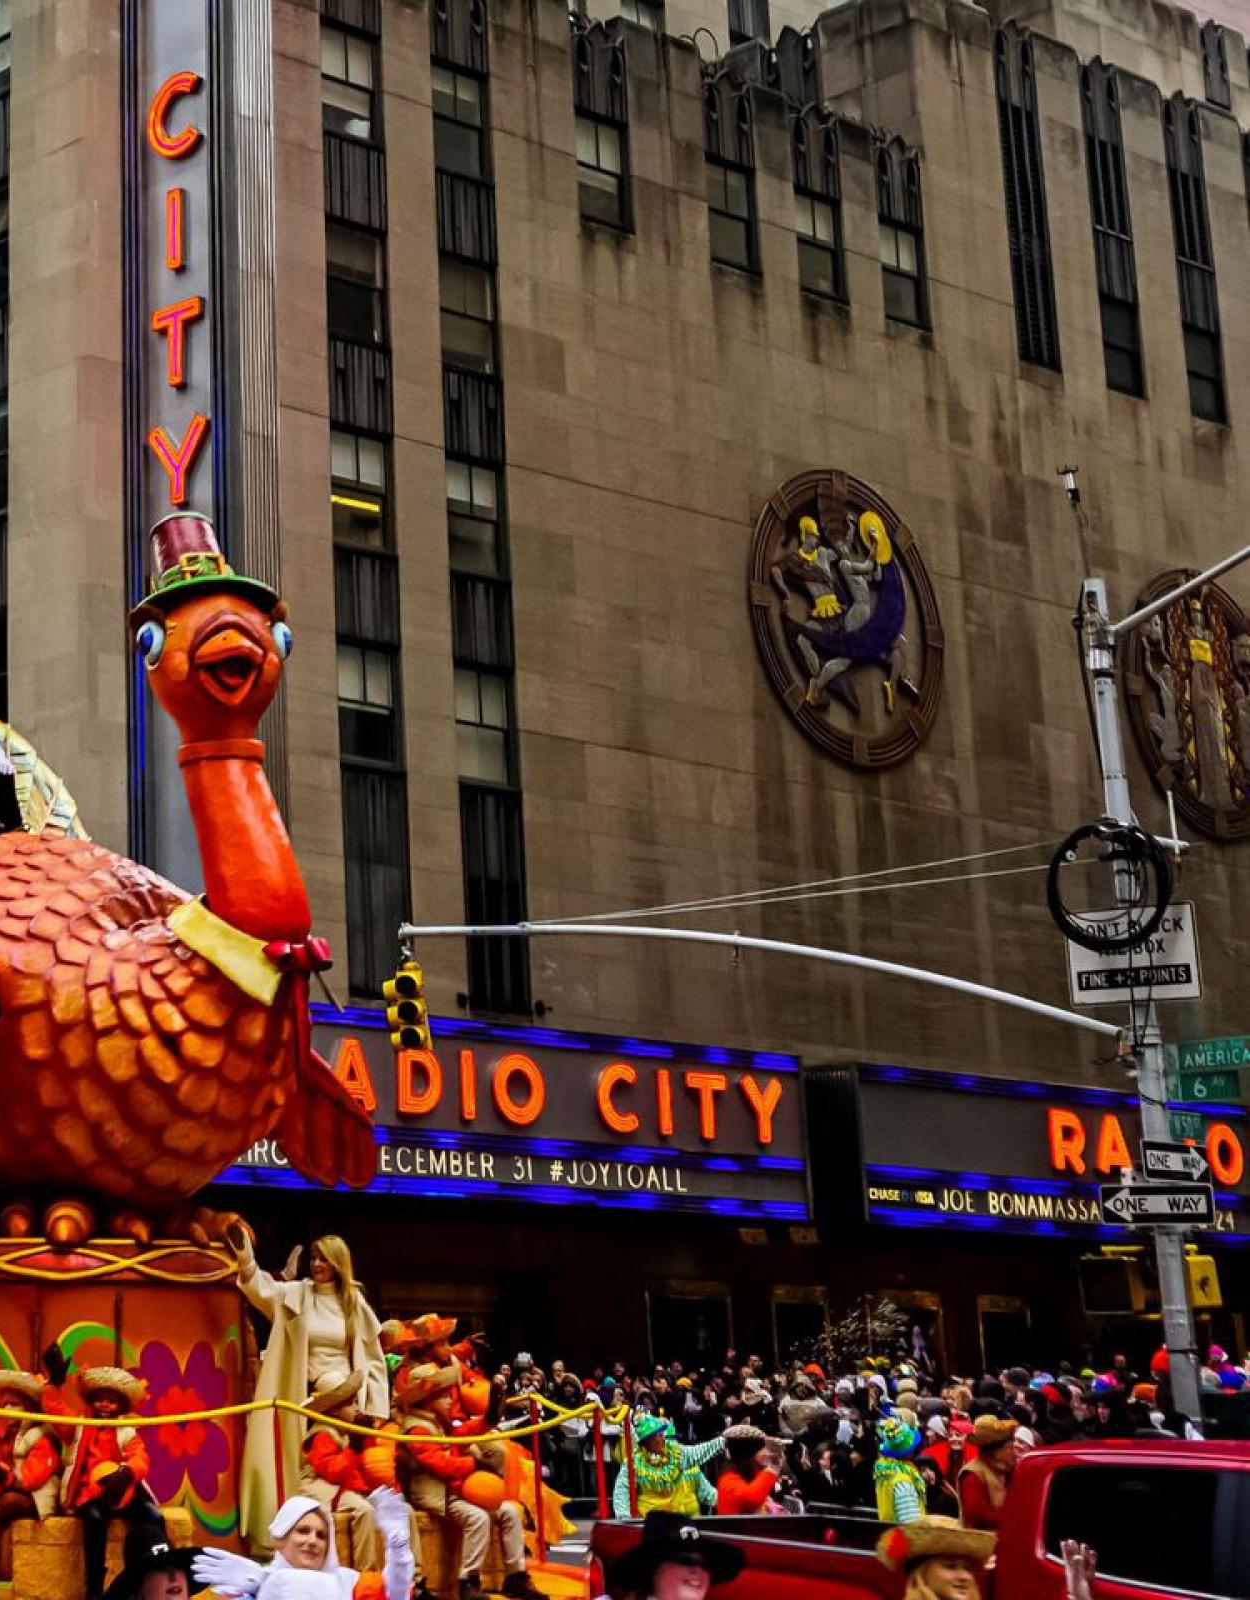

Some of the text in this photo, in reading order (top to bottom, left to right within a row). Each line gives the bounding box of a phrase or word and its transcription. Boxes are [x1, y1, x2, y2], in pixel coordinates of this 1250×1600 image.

[147, 71, 210, 507] CITY
[1081, 971, 1110, 989] FINE
[1139, 966, 1187, 984] POINTS
[330, 1037, 784, 1145] ADIO CITY
[1194, 1075, 1208, 1098] 6
[1047, 1106, 1245, 1186] RAO
[1149, 1151, 1171, 1169] ONE
[379, 1146, 688, 1193] ECEMBER 31 #JOYTOALL
[939, 1187, 975, 1213] JOE
[988, 1190, 1101, 1221] BONAMASSA
[1112, 1196, 1203, 1213] ONE WAY
